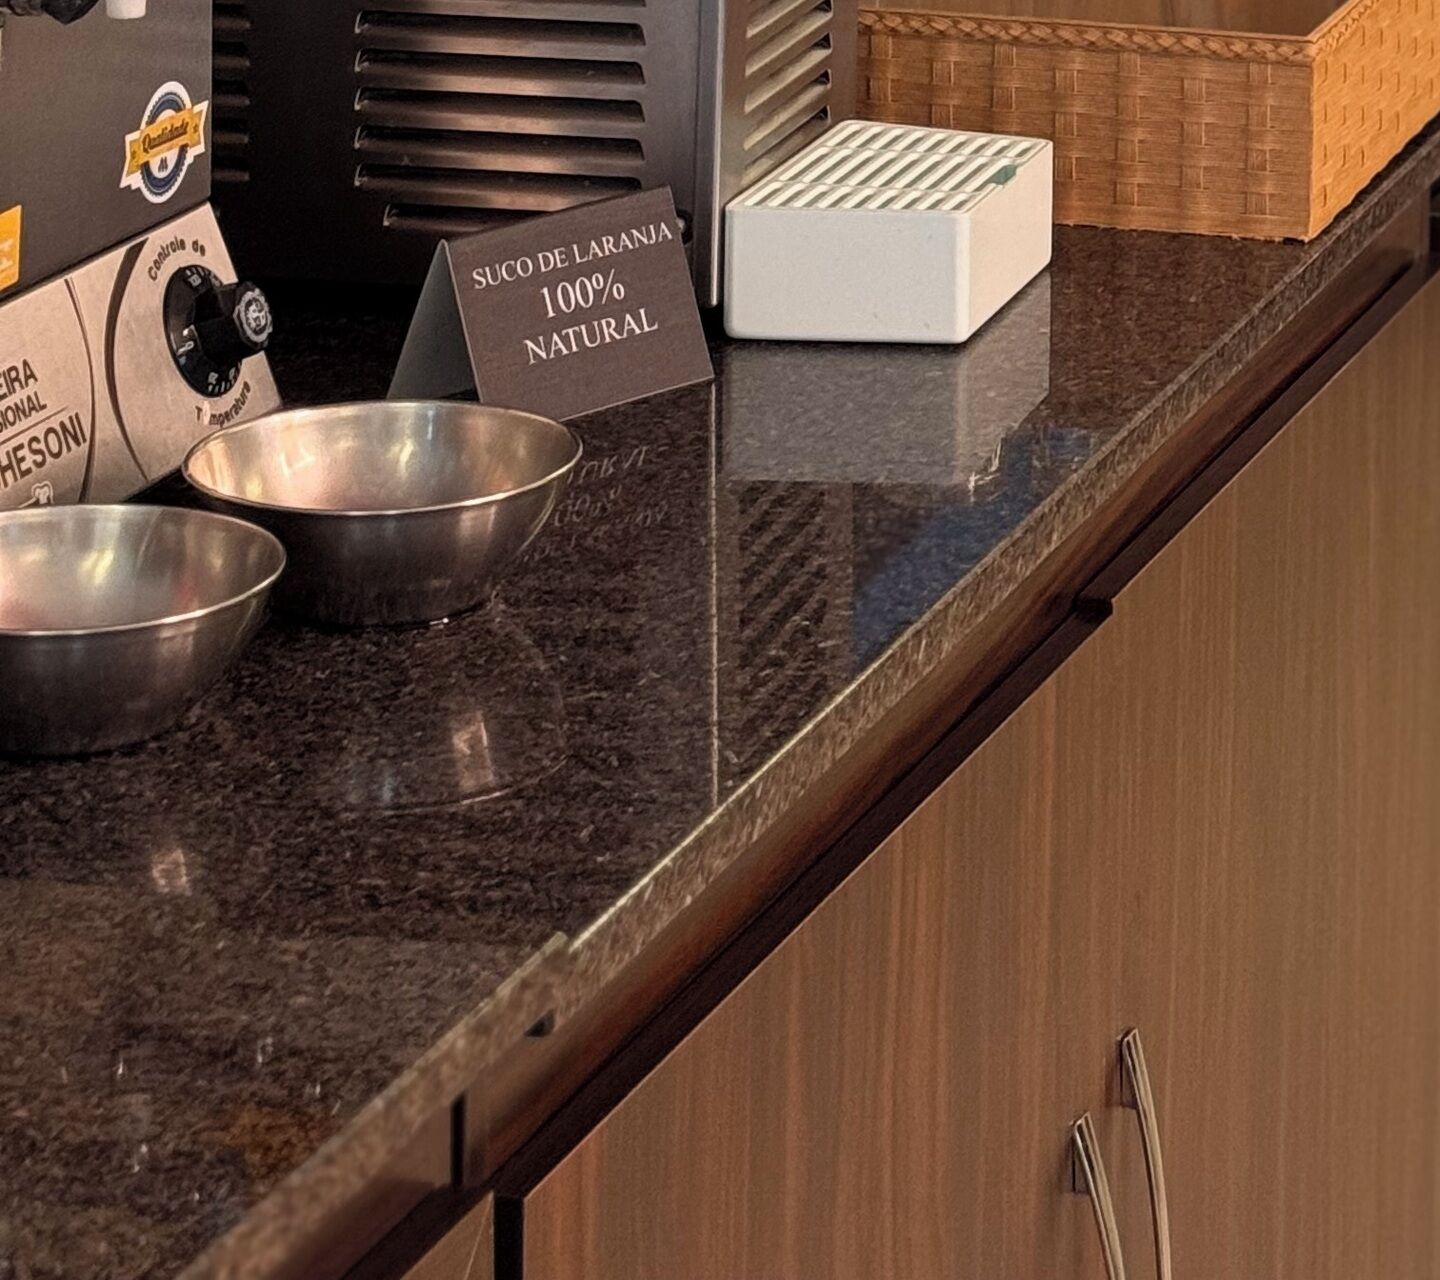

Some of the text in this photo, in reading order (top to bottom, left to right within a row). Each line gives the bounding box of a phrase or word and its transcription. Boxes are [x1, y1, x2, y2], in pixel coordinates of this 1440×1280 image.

[472, 221, 673, 289] SUCO DE LARANJA
[540, 268, 625, 319] 100%
[523, 308, 659, 365] NATURAL
[0, 391, 48, 433] IONAL
